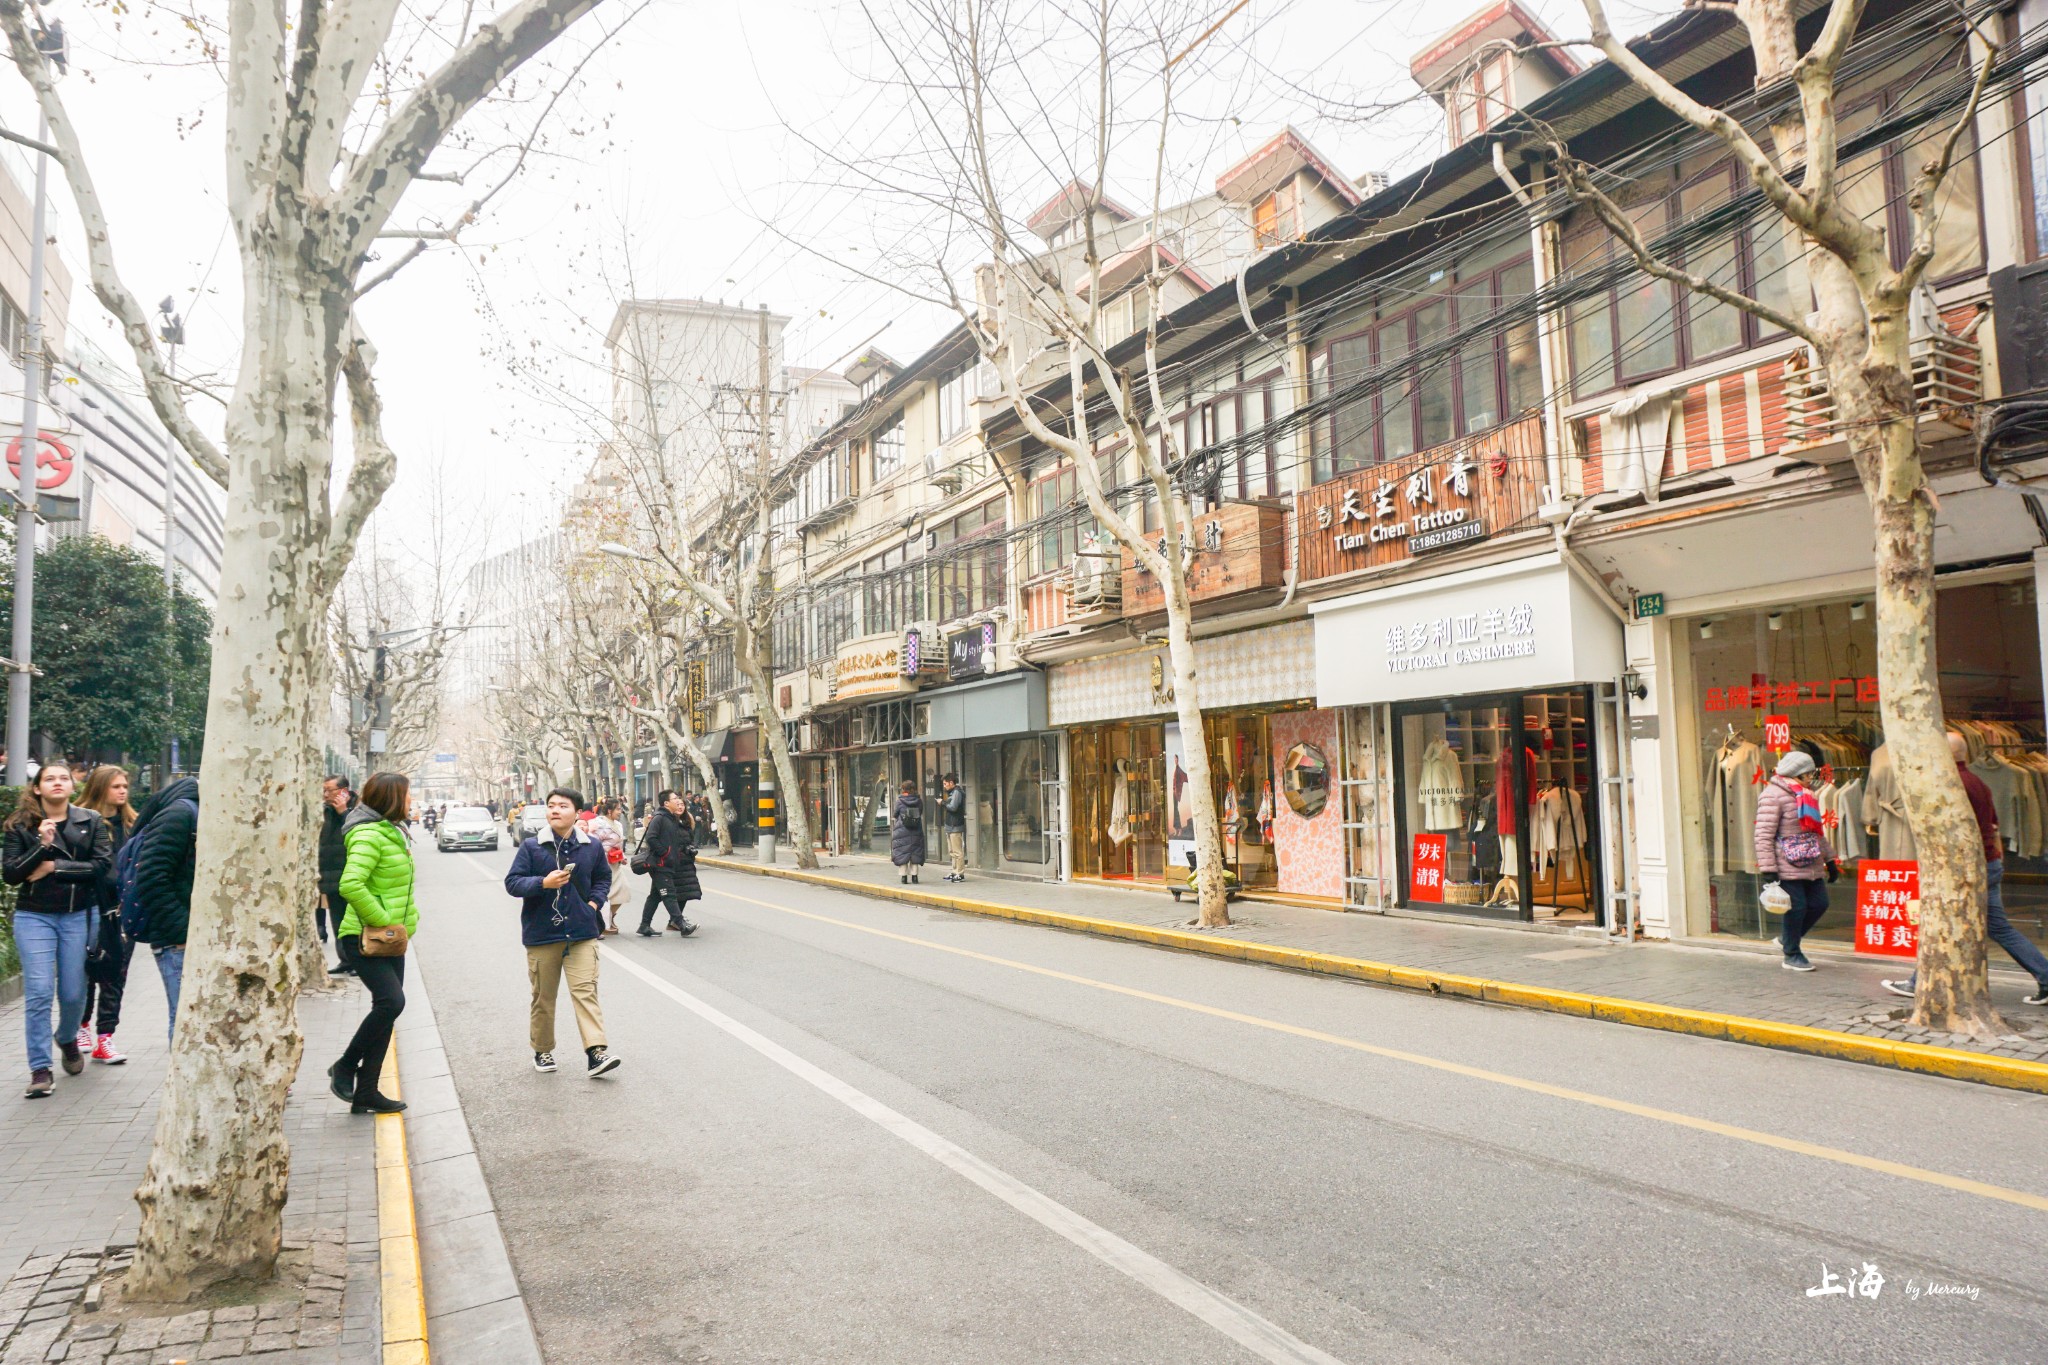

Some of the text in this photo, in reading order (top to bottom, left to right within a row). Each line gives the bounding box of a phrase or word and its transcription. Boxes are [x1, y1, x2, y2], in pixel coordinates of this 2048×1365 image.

[1334, 508, 1465, 551] Tian Chen Tattoo
[1410, 523, 1481, 550] T:18621285710
[1642, 596, 1660, 610] 254
[1386, 603, 1534, 655] 维多利亚羊绒
[953, 640, 968, 662] My
[1454, 640, 1536, 665] CASHMERE
[1705, 675, 1880, 711] 品牌羊绒工厂店
[1766, 723, 1789, 745] 799
[1418, 842, 1441, 861] 岁末
[1416, 867, 1440, 887] 清货
[1861, 904, 1908, 921] 羊绒大
[1865, 923, 1912, 948] 特卖
